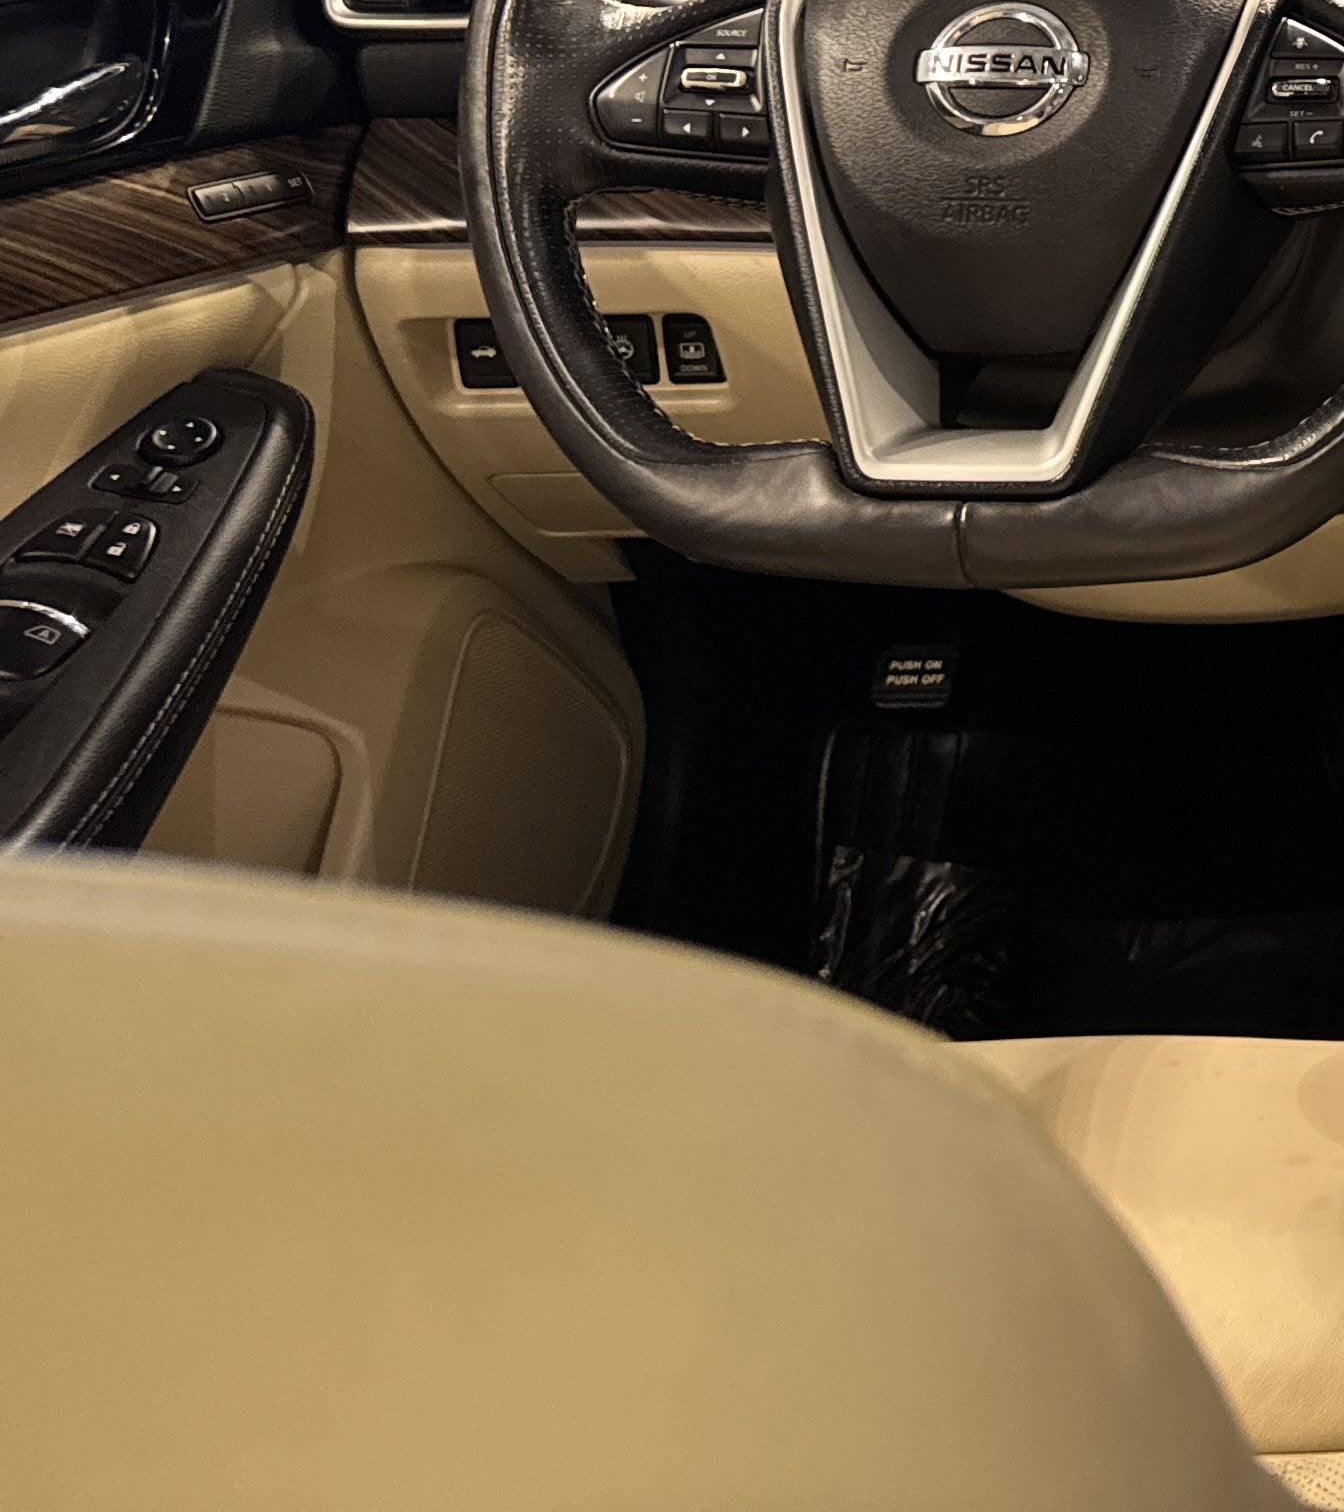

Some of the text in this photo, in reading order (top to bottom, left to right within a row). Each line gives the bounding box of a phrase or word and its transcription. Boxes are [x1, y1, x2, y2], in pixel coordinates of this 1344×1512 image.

[930, 53, 1068, 76] NISSAN
[1281, 83, 1314, 92] CANCEL
[963, 175, 1007, 197] SRS
[940, 204, 1031, 224] AIRBAG
[888, 659, 943, 671] PUSH ON
[885, 673, 946, 686] PUSH OFF
